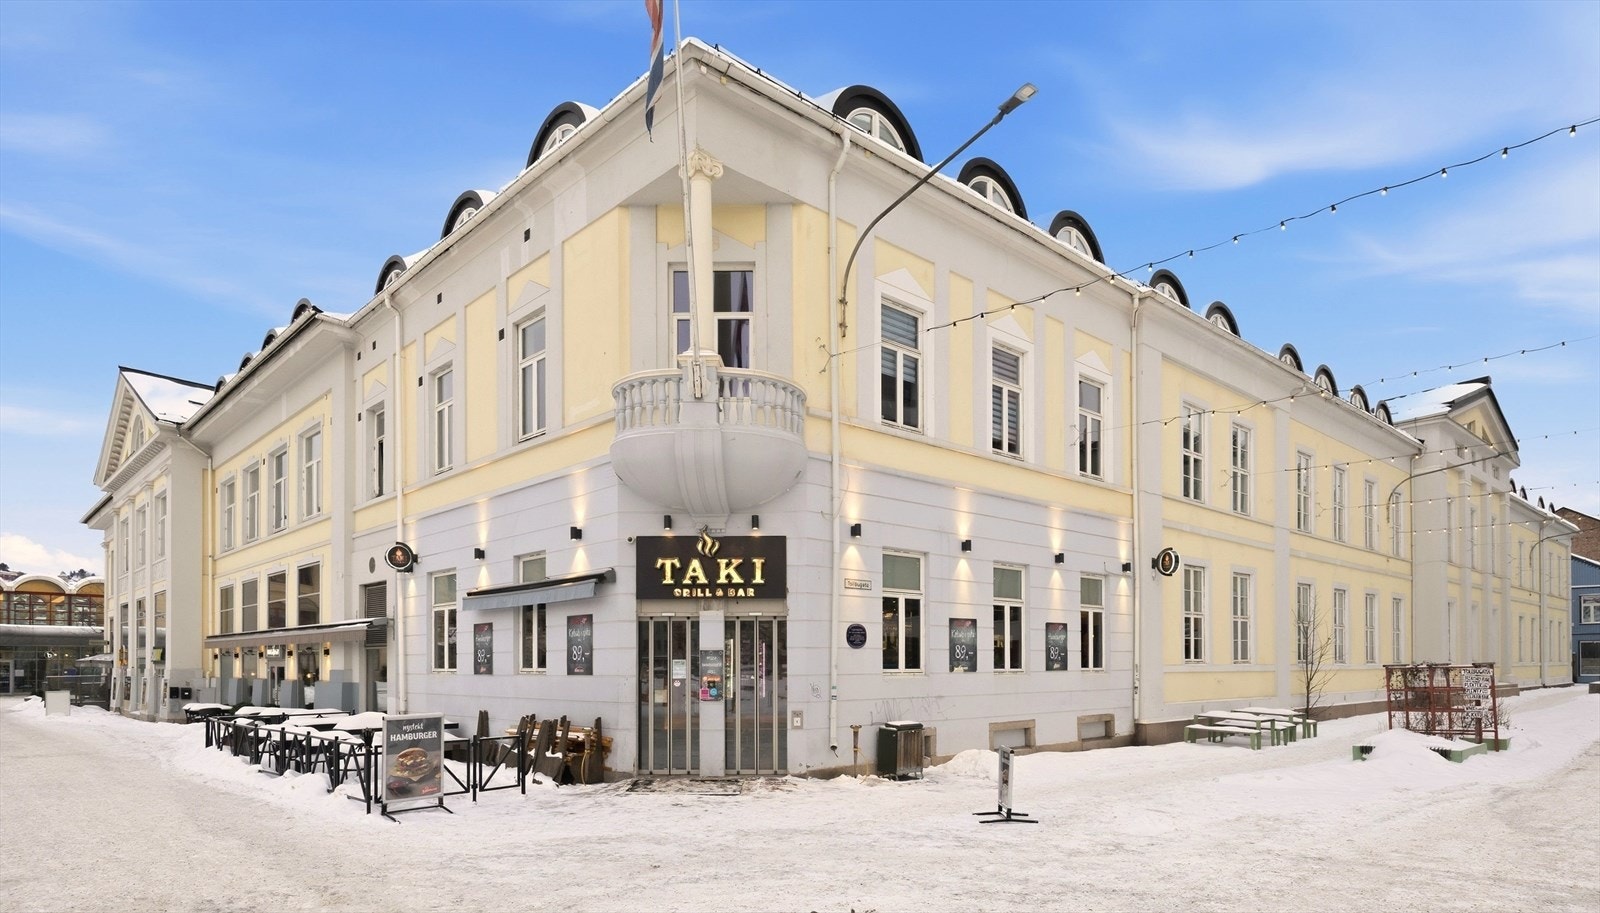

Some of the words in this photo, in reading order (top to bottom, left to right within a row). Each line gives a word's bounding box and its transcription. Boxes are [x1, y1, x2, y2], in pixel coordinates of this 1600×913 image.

[655, 556, 767, 585] TAKI
[673, 588, 712, 598] GRILL
[728, 588, 755, 598] BAR
[390, 731, 437, 742] HAMBURGER
